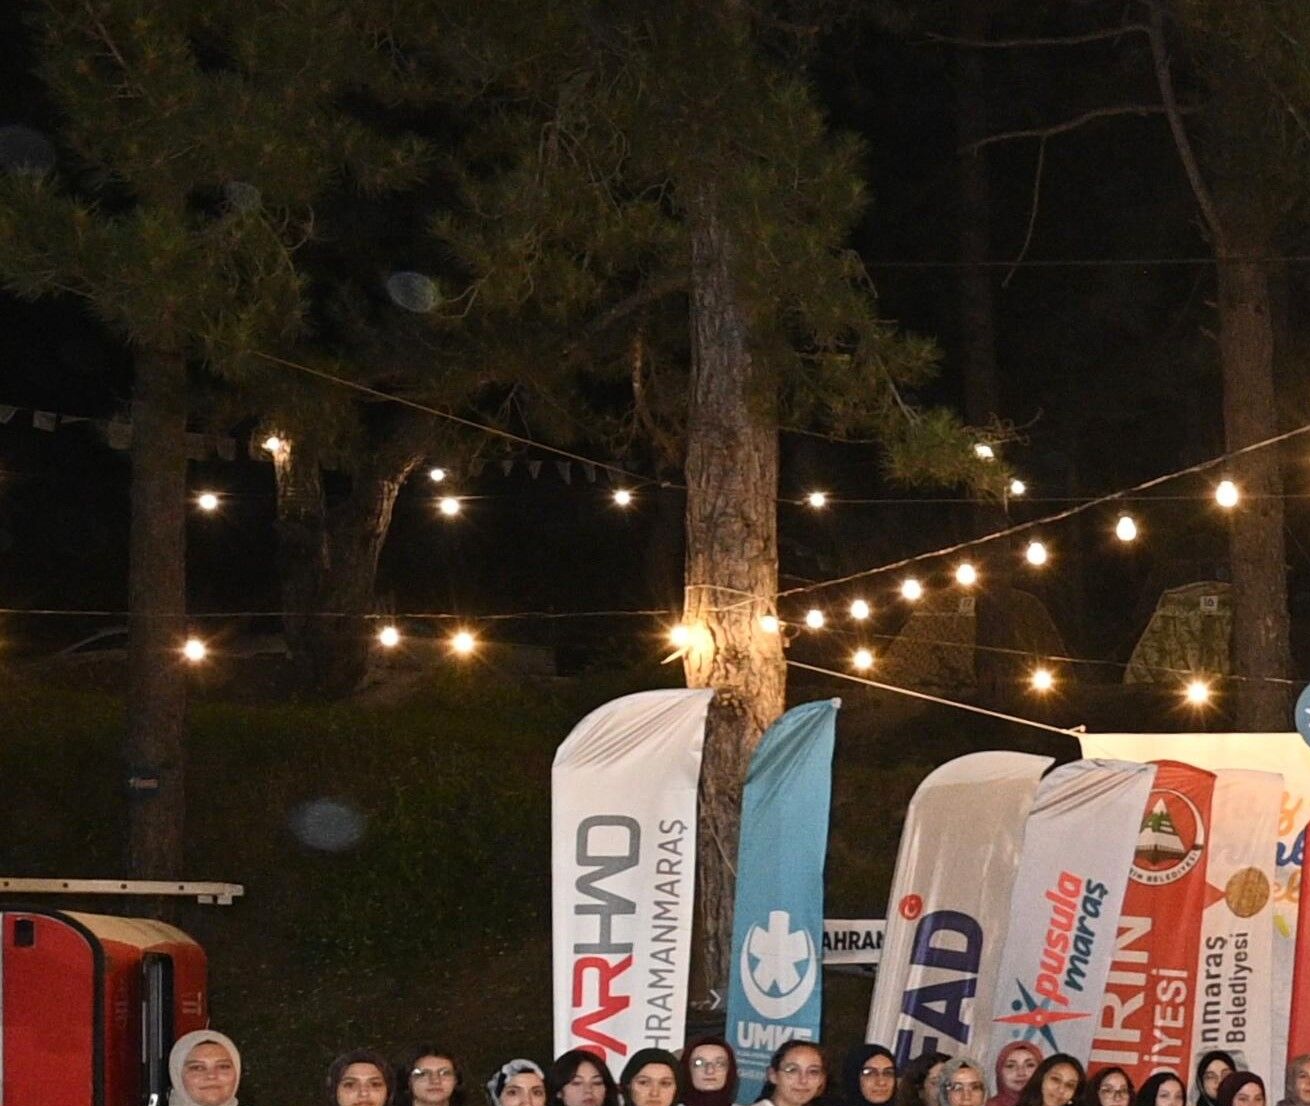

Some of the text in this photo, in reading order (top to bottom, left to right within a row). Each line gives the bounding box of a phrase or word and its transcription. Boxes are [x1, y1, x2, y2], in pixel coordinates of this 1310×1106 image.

[1035, 870, 1084, 1007] pusula
[1065, 879, 1108, 992] maraş
[1225, 932, 1253, 1044] Belediyesi
